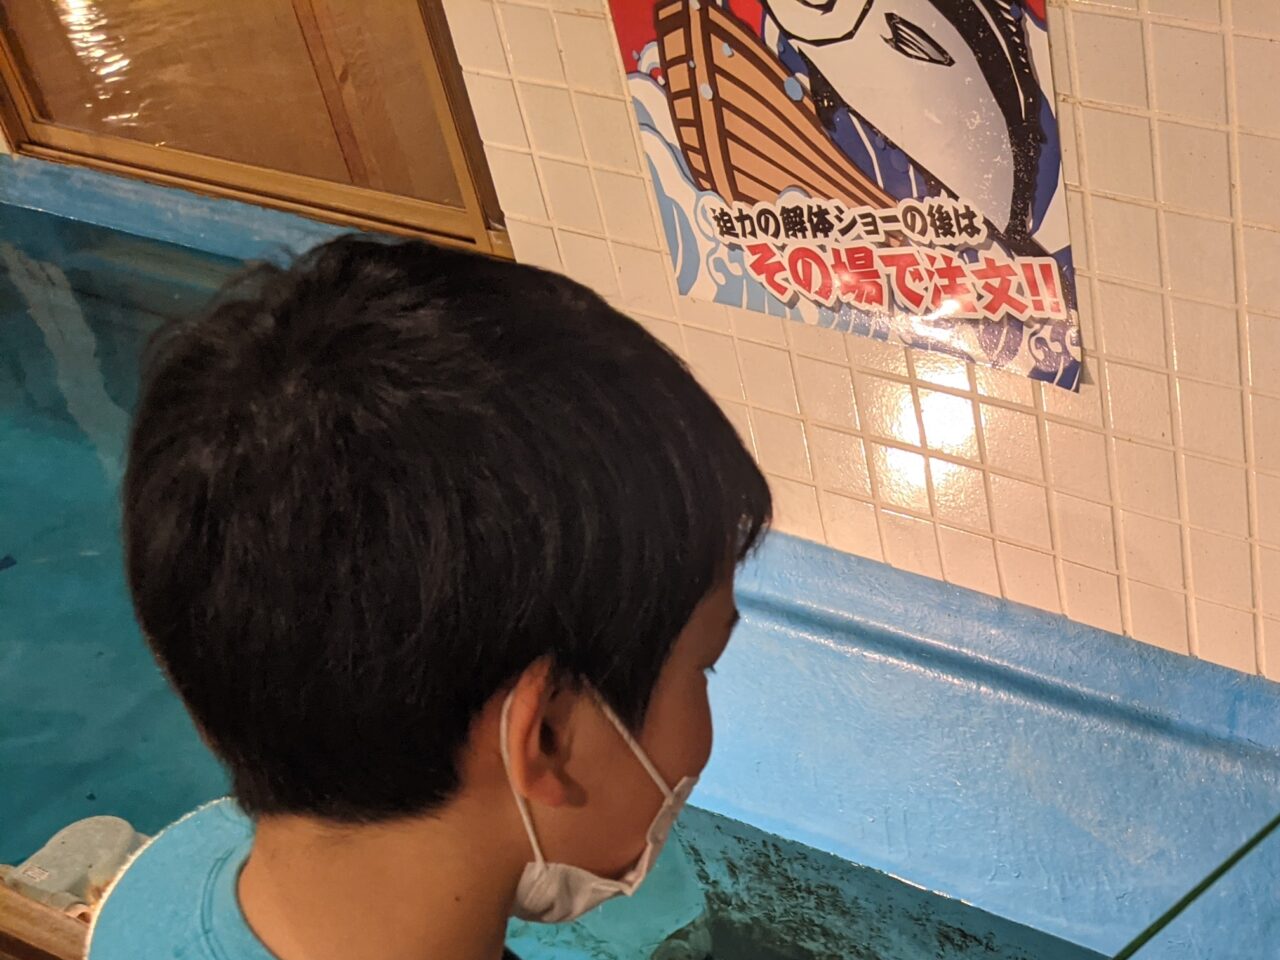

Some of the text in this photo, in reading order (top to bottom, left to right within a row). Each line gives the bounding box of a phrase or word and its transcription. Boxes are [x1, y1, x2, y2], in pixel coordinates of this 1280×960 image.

[712, 203, 983, 240] 迫力の解体ショーの後は
[745, 242, 1062, 315] その場で注文!!
